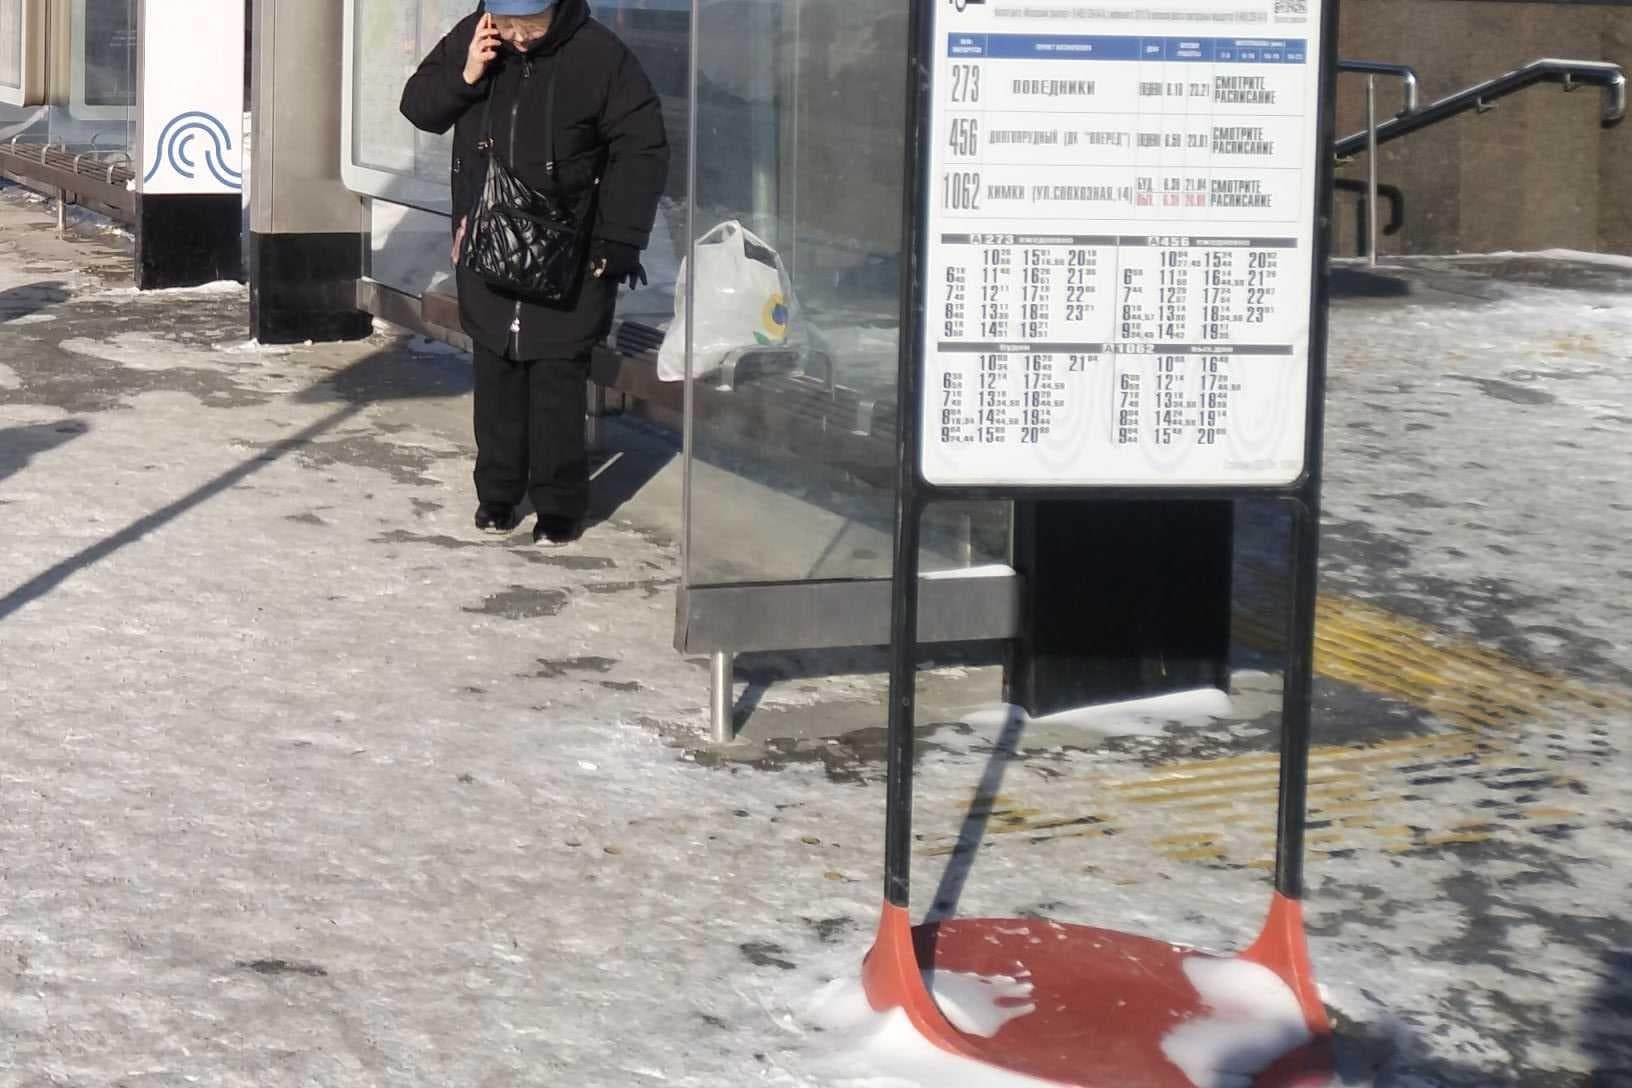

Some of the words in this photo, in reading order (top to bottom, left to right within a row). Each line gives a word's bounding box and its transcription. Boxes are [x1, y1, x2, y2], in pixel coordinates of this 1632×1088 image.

[951, 64, 980, 102] 273
[1012, 79, 1096, 96] ПОВЕДНИКИ
[1215, 76, 1265, 90] СМОТРИТЕ
[949, 118, 978, 156] 456
[1213, 127, 1263, 141] СМОТРИТЕ
[944, 172, 980, 210] 1062
[987, 185, 1025, 200] ХИМКИ
[1211, 179, 1261, 193] СМОТРИТЕ
[981, 234, 1014, 244] 273
[984, 249, 999, 265] 10
[1024, 249, 1040, 265] 15
[1068, 250, 1085, 266] 20
[1160, 251, 1177, 267] 10
[1205, 252, 1221, 267] 15
[1249, 252, 1266, 268] 20
[946, 267, 954, 282] 6
[983, 267, 997, 283] 11
[1024, 268, 1039, 284] 16
[1068, 268, 1083, 284] 21
[1124, 269, 1132, 284] 6
[1160, 270, 1174, 285] 11
[1205, 270, 1220, 286] 16
[1248, 270, 1263, 286] 21
[946, 284, 953, 301] 7
[982, 286, 998, 301] 12
[1023, 286, 1038, 302] 17
[1067, 286, 1084, 302] 22
[1124, 287, 1131, 302] 7
[1160, 287, 1175, 303] 12
[1204, 288, 1219, 304] 17
[1248, 288, 1264, 304] 22
[945, 303, 953, 319] 8
[981, 304, 997, 319] 13
[1022, 304, 1038, 320] 18
[1066, 305, 1083, 320] 23
[1123, 305, 1130, 320] 8
[1160, 305, 1174, 321] 13
[1203, 306, 1219, 321] 18
[1247, 307, 1264, 322] 23
[945, 321, 952, 337] 9
[981, 322, 997, 337] 14
[1021, 322, 1037, 338] 19
[1122, 323, 1130, 338] 9
[1158, 323, 1173, 339] 14
[1202, 324, 1218, 339] 19
[980, 355, 996, 370] 10
[1025, 355, 1040, 371] 16
[1069, 356, 1084, 371] 21
[1158, 356, 1173, 372] 10
[1202, 357, 1217, 372] 16
[944, 372, 951, 388] 6
[980, 373, 996, 389] 12
[1024, 373, 1040, 389] 17
[1121, 374, 1129, 390] 6
[1157, 374, 1173, 390] 12
[1202, 374, 1216, 390] 17
[944, 391, 950, 406] 7
[979, 391, 995, 407] 13
[1024, 391, 1040, 407] 18
[1121, 392, 1128, 407] 7
[1156, 392, 1172, 408] 13
[1200, 393, 1216, 408] 18
[942, 409, 950, 424] 8
[978, 409, 994, 424] 14
[1024, 409, 1039, 425] 19
[1120, 409, 1127, 425] 8
[1155, 410, 1171, 425] 14
[1200, 411, 1215, 426] 19
[941, 427, 949, 442] 9
[978, 427, 993, 443] 15
[1021, 427, 1038, 443] 20
[1119, 428, 1127, 443] 9
[1155, 428, 1170, 444] 15
[1198, 428, 1215, 444] 20
